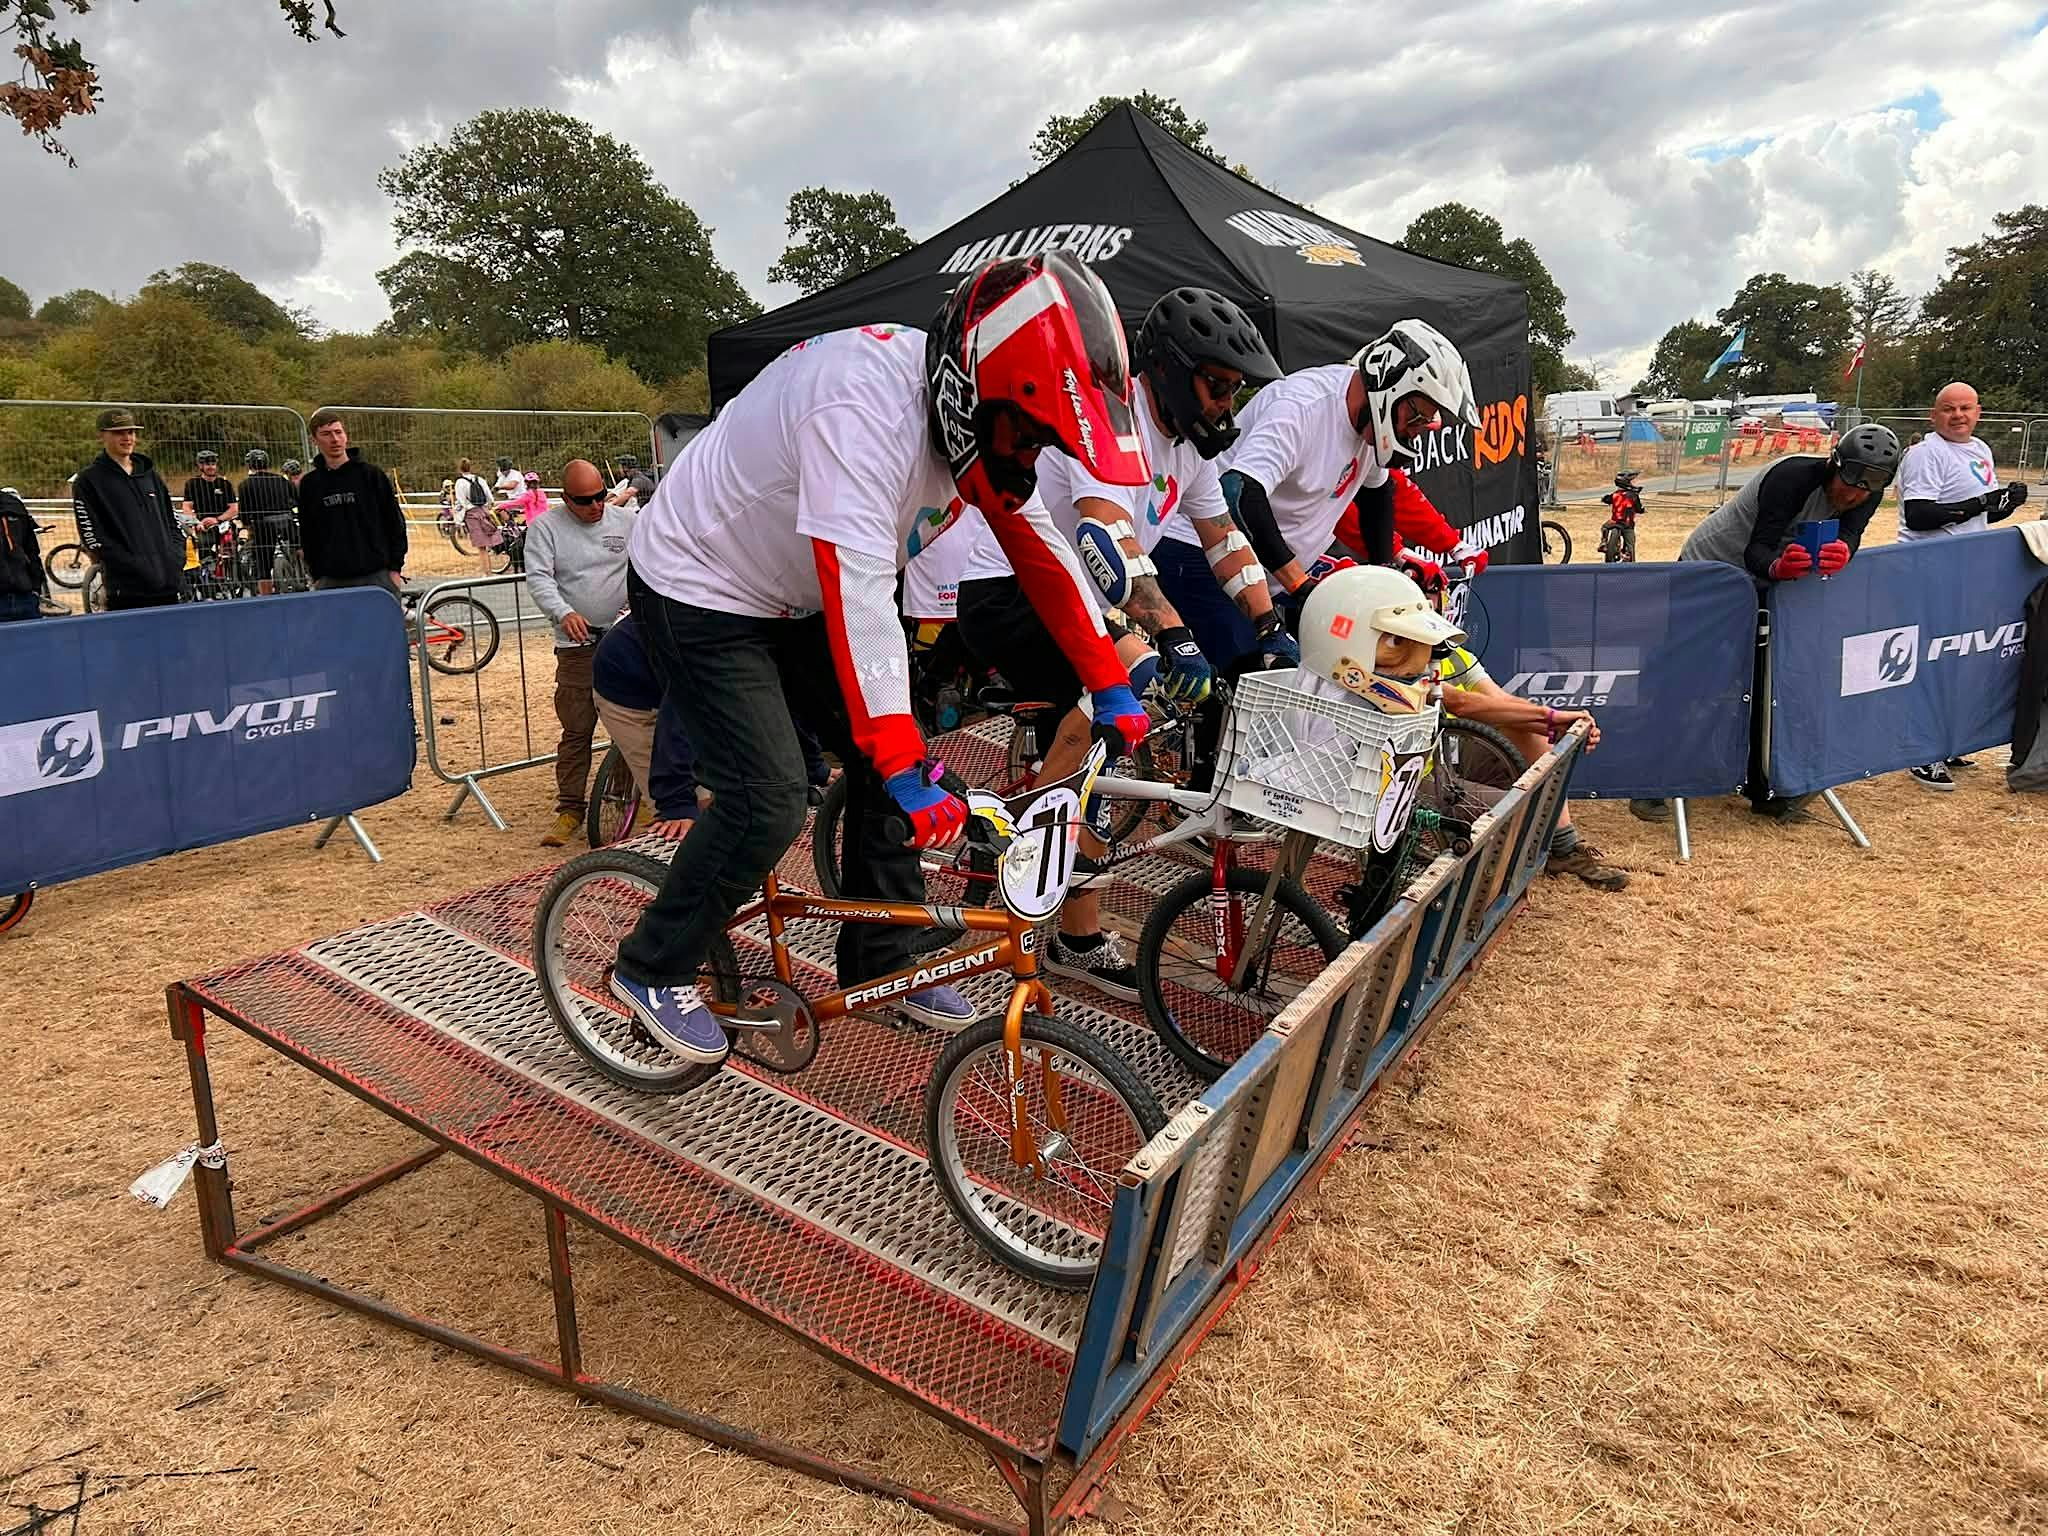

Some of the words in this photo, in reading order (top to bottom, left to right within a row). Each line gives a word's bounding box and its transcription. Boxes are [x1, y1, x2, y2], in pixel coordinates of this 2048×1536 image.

[937, 223, 1133, 273] MALVERNS
[1402, 422, 1469, 475] BACK
[1927, 620, 2027, 662] PIVO
[121, 690, 337, 750] PIVOT
[245, 718, 316, 741] CYCLES
[1032, 801, 1068, 899] 71
[804, 904, 893, 919] Maverick
